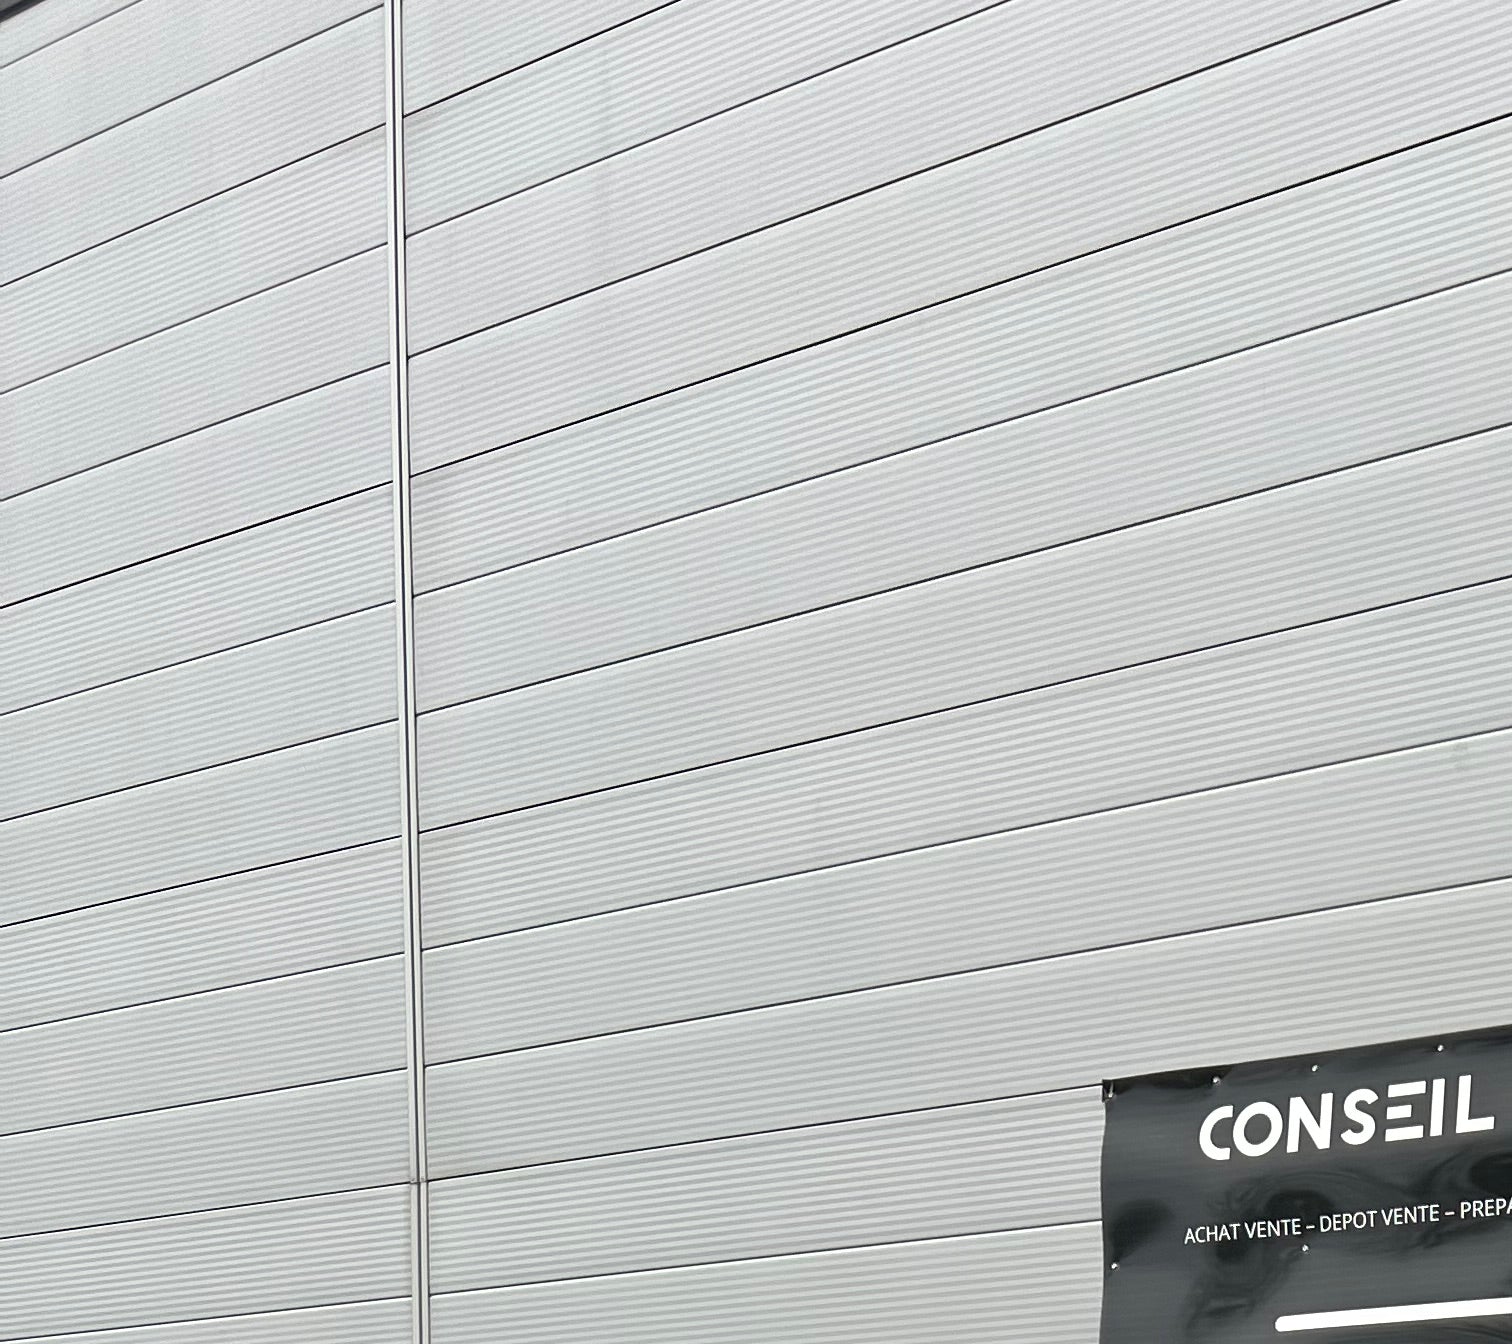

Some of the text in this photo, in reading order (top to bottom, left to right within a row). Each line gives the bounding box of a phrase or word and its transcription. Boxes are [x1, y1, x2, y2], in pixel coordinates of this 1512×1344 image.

[1199, 1074, 1495, 1161] CONSEIL
[1184, 1223, 1241, 1244] ACHAT
[1244, 1218, 1302, 1239] VENTE
[1319, 1210, 1378, 1233] DEPOT
[1381, 1204, 1440, 1226] VENTE
